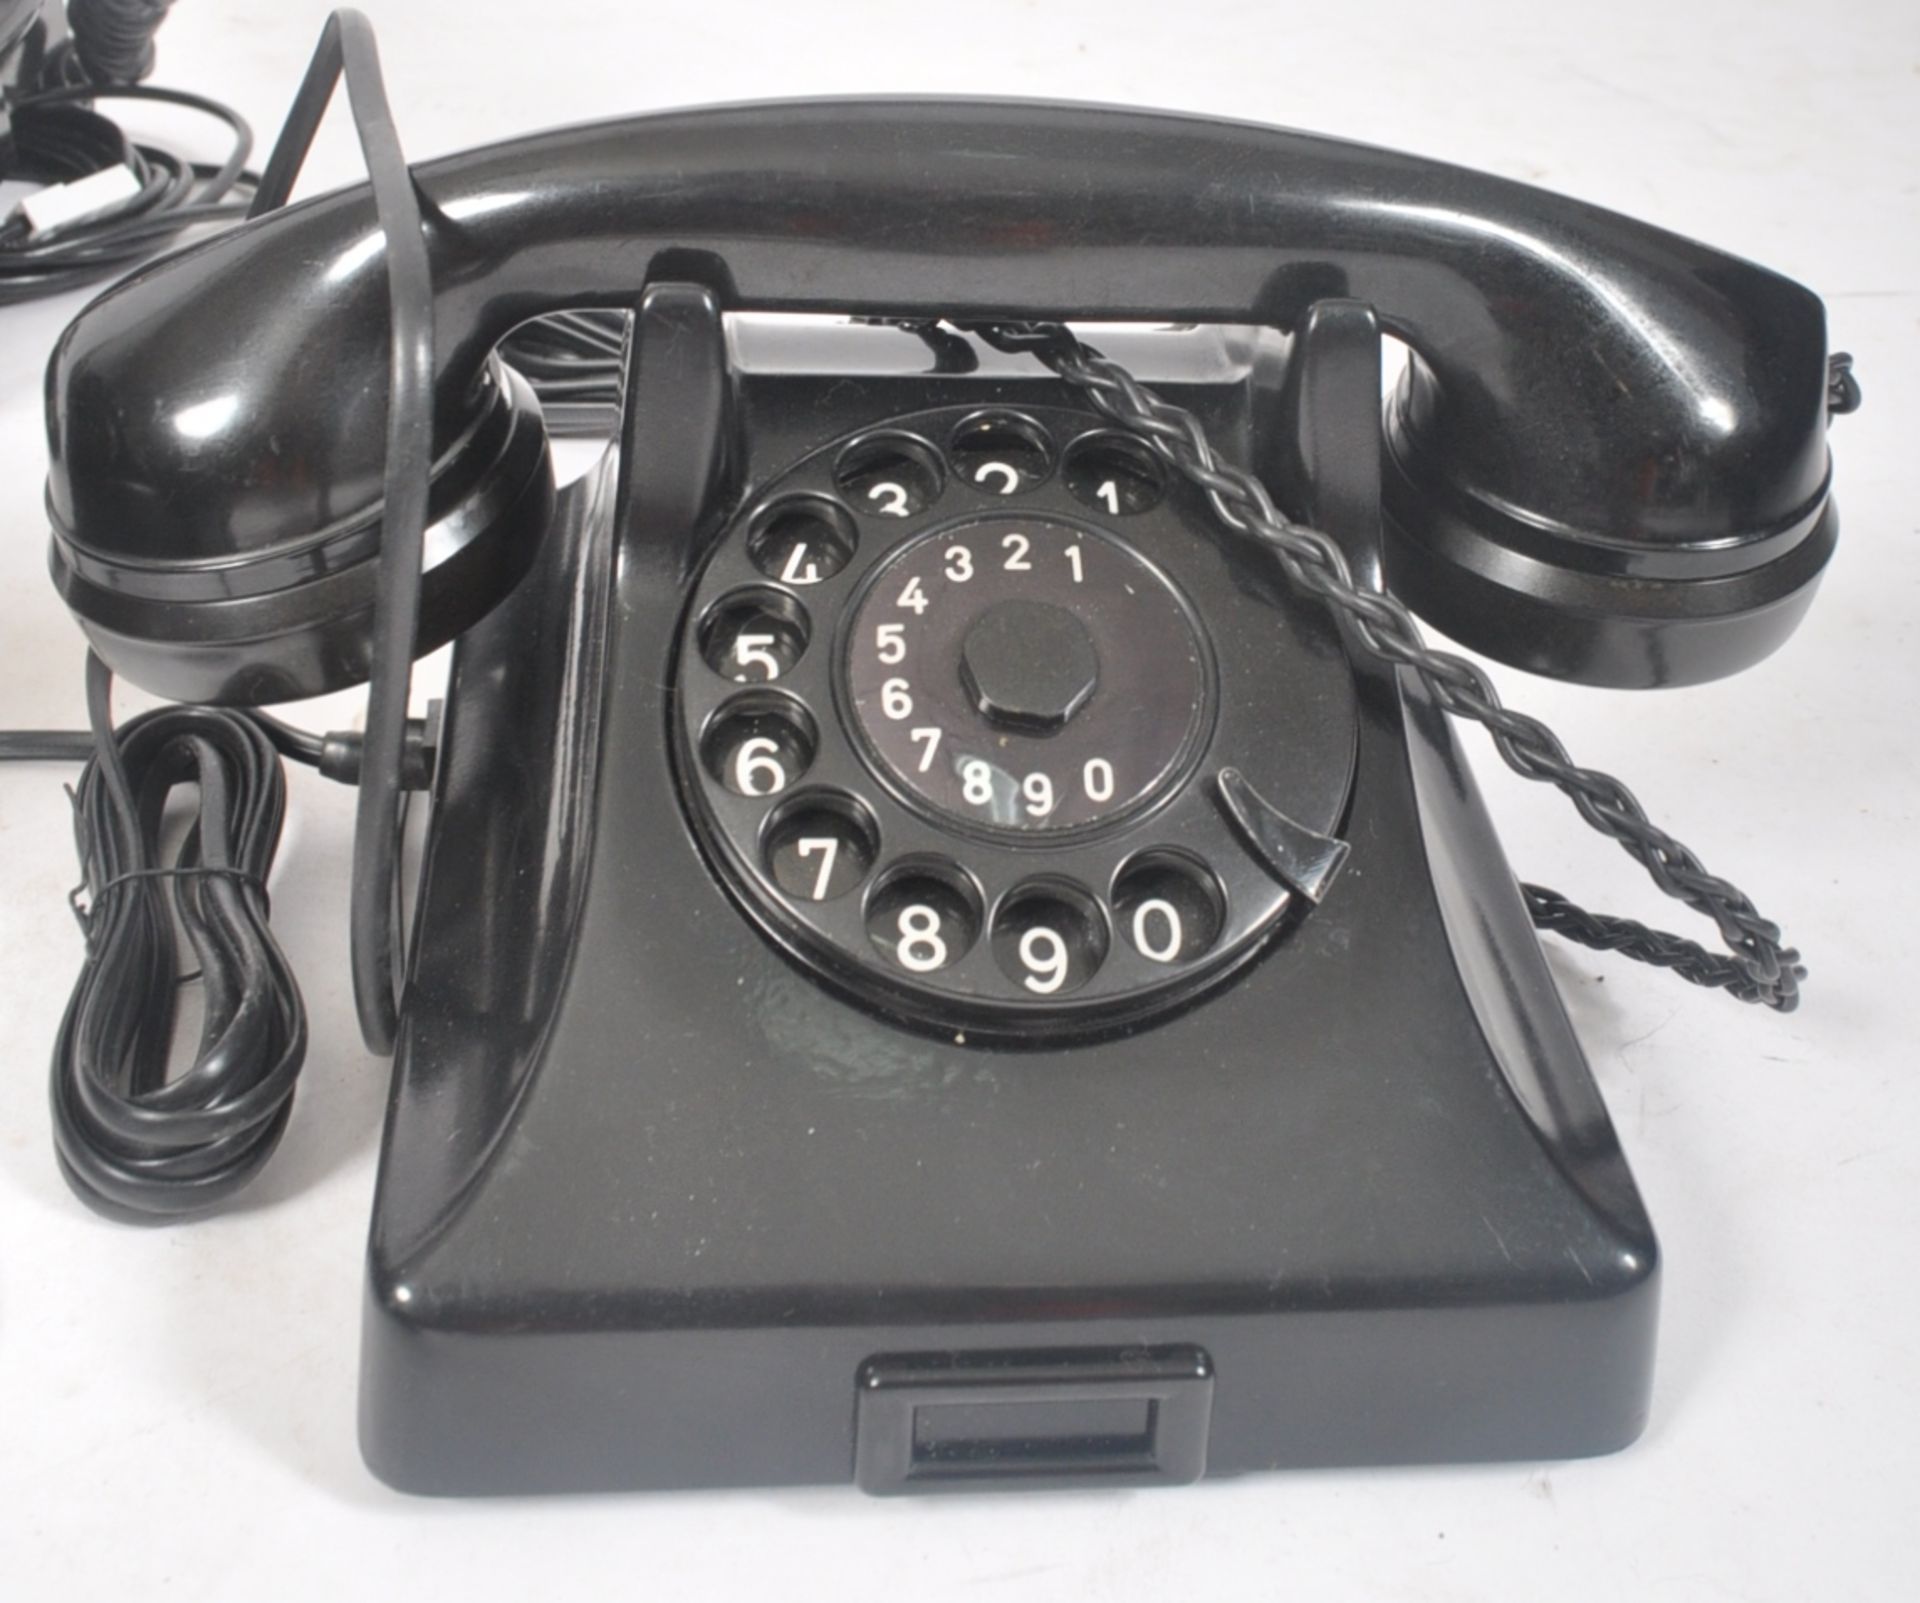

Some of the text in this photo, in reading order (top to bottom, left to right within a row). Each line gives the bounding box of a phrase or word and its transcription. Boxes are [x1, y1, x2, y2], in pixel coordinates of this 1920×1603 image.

[1096, 481, 1119, 515] 1
[780, 542, 823, 585] 4
[944, 545, 974, 583] 3
[1002, 533, 1033, 571] 2
[1064, 545, 1084, 583] 1
[896, 576, 929, 615] 4
[735, 634, 779, 681] 5
[876, 623, 907, 664] 5
[880, 678, 914, 720] 6
[735, 737, 786, 797] 6
[910, 727, 942, 773] 7
[962, 760, 993, 805] 8
[1023, 772, 1054, 816] 9
[1083, 757, 1115, 803] 0
[798, 838, 838, 901] 7
[897, 905, 947, 972] 8
[1132, 899, 1182, 963] 0
[1019, 927, 1069, 994] 9
